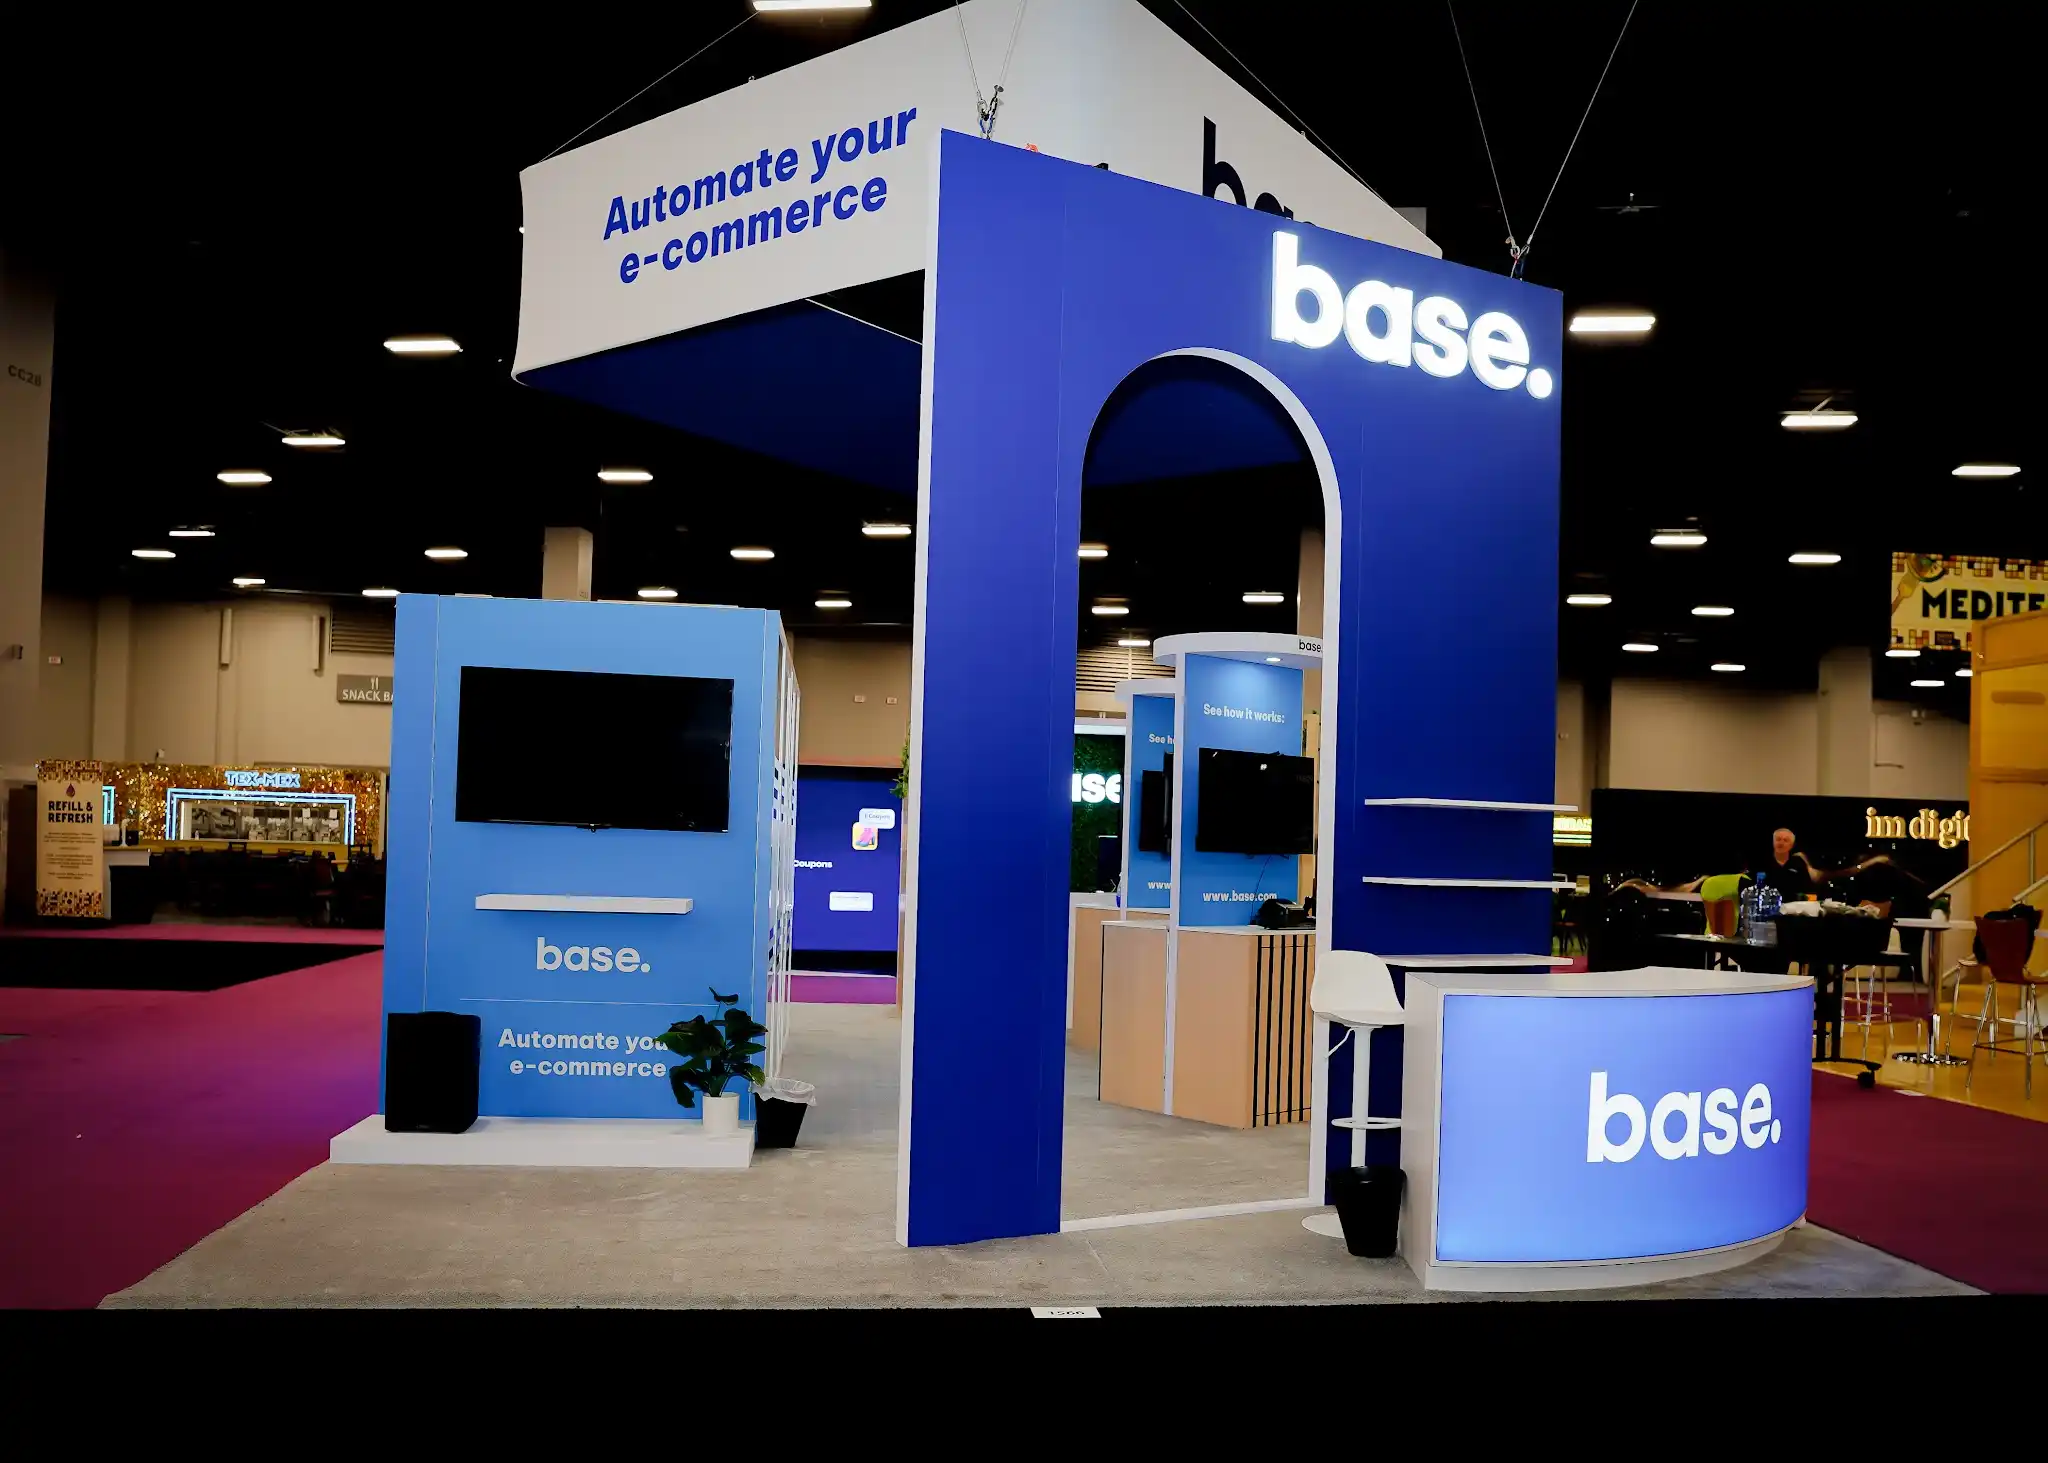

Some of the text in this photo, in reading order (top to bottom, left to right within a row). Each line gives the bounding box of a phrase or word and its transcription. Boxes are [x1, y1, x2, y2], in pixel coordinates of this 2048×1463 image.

[603, 107, 917, 240] Automate your
[619, 176, 888, 284] e-commerce
[1271, 230, 1553, 400] base.
[342, 688, 381, 701] SNACK
[1203, 703, 1285, 724] See how it works:
[1148, 733, 1166, 744] See
[225, 770, 301, 788] TEX-MEX
[1071, 773, 1121, 803] se
[48, 801, 93, 812] REFILL &
[48, 813, 93, 824] REFRESH
[1865, 806, 1907, 838] im
[1203, 889, 1278, 902] www.base.com
[536, 936, 651, 973] base.
[498, 1028, 620, 1051] Automate
[509, 1059, 667, 1078] e-commerce
[1586, 1071, 1782, 1163] base.
